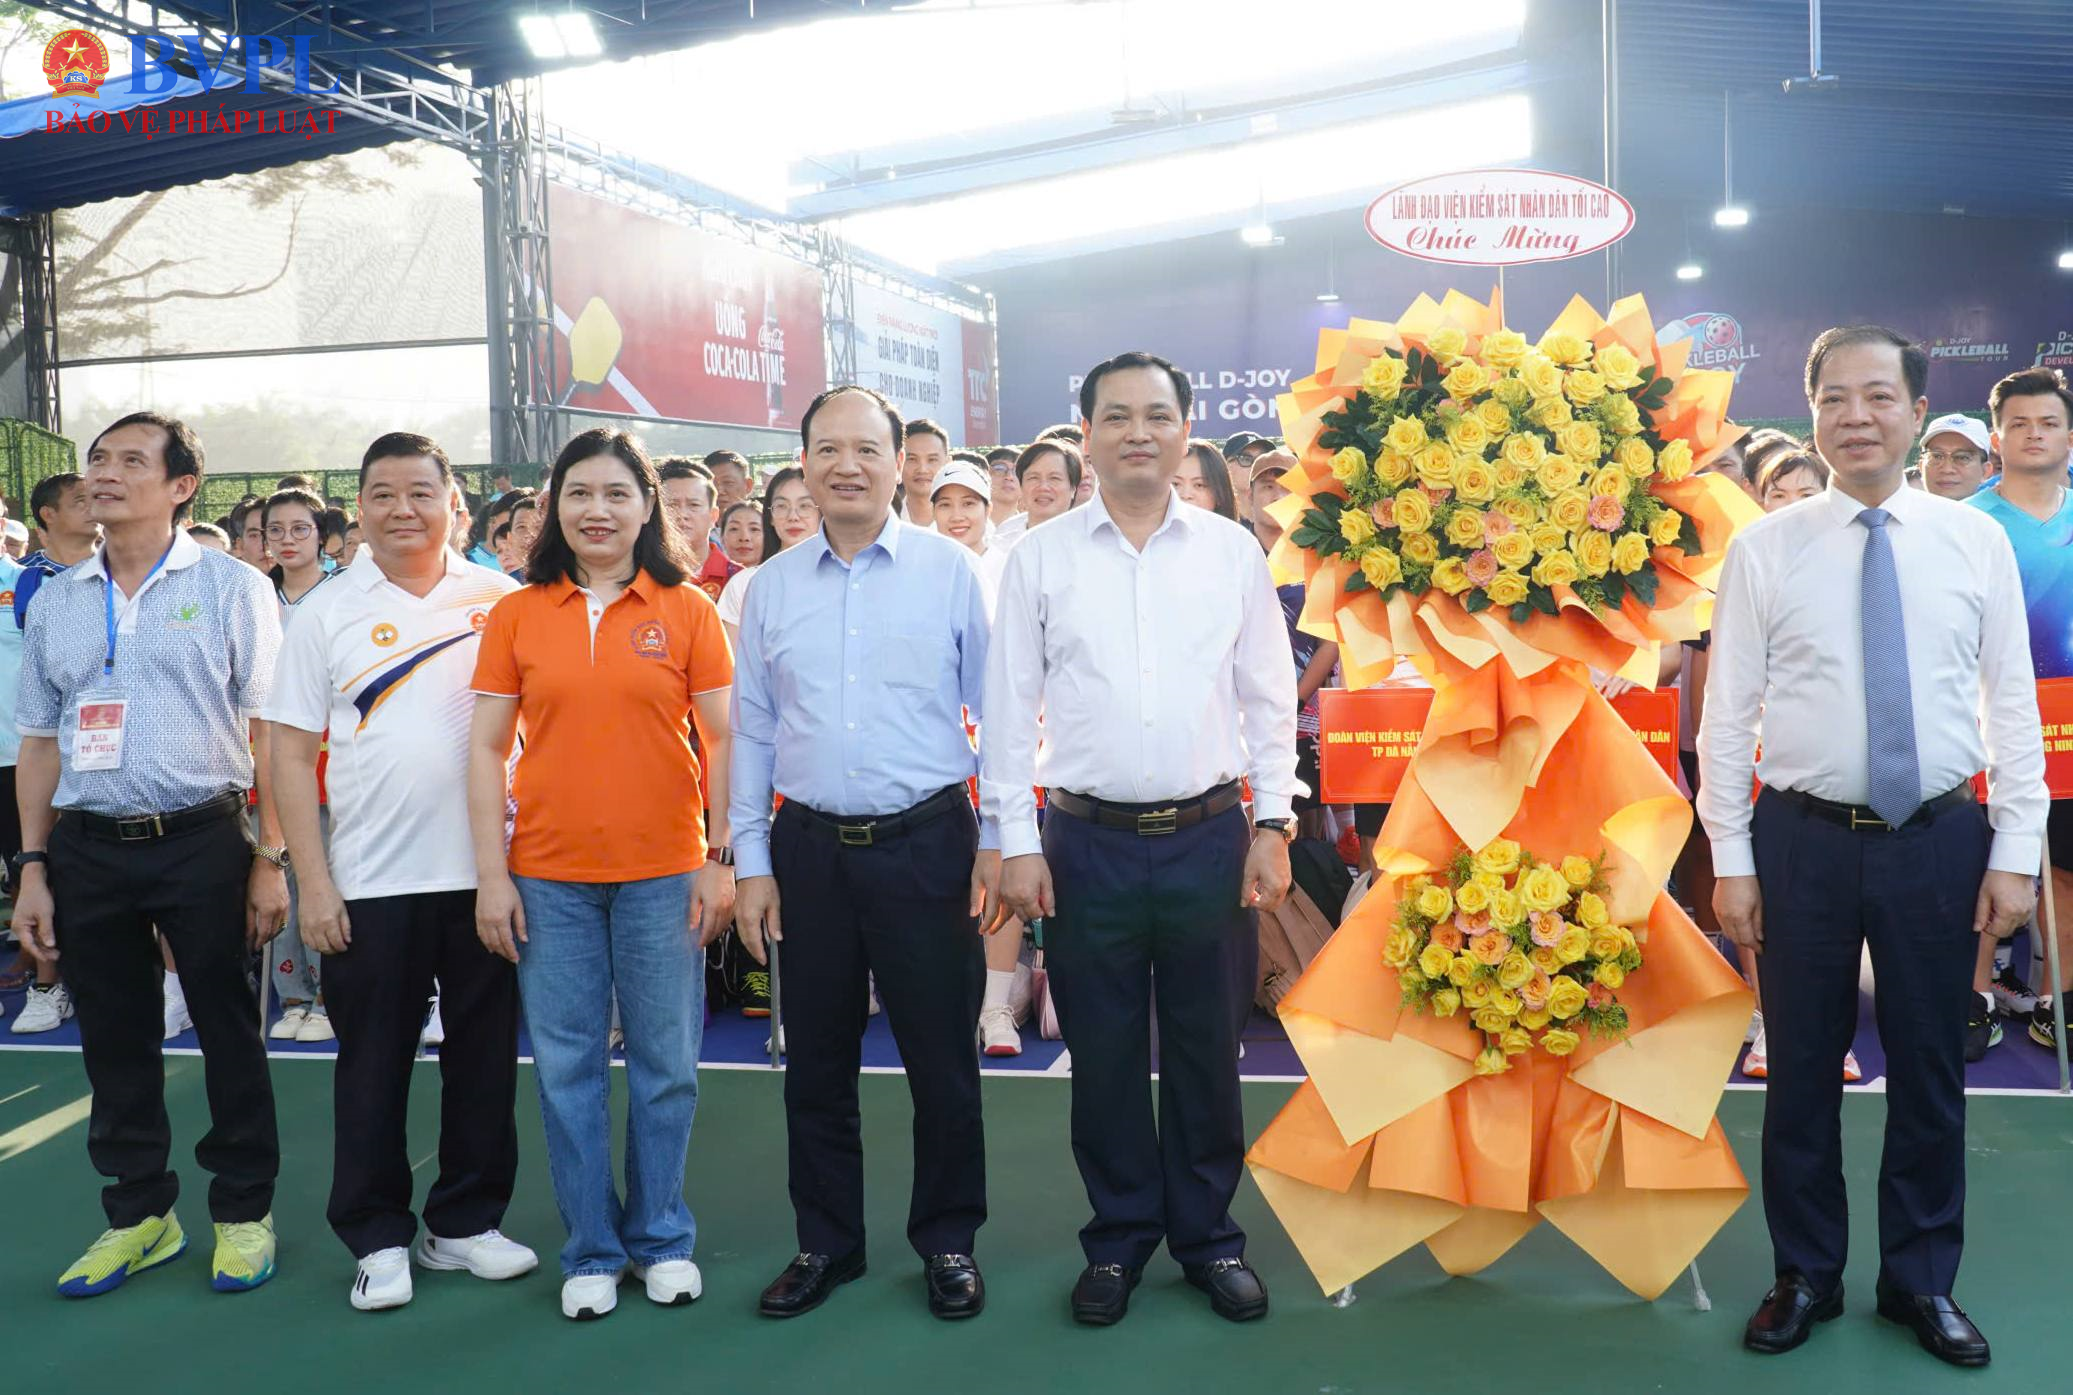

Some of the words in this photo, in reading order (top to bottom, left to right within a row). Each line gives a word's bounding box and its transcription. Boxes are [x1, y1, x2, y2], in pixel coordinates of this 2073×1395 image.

[1420, 194, 1440, 225] ĐẠO
[1444, 189, 1467, 225] VIỆN
[1469, 184, 1495, 219] KIỂM
[1497, 186, 1516, 218] SÁT
[1520, 189, 1546, 218] NHÂN
[1549, 189, 1569, 218] DÂN
[1590, 193, 1610, 218] CAO
[1406, 226, 1478, 250] Chúc
[1493, 224, 1580, 253] Mừng
[1930, 343, 2009, 358] PICKLEBALL
[759, 350, 787, 386] TIME
[1218, 369, 1291, 389] D-JOY
[895, 375, 917, 401] DOANH
[1371, 746, 1384, 758] TP
